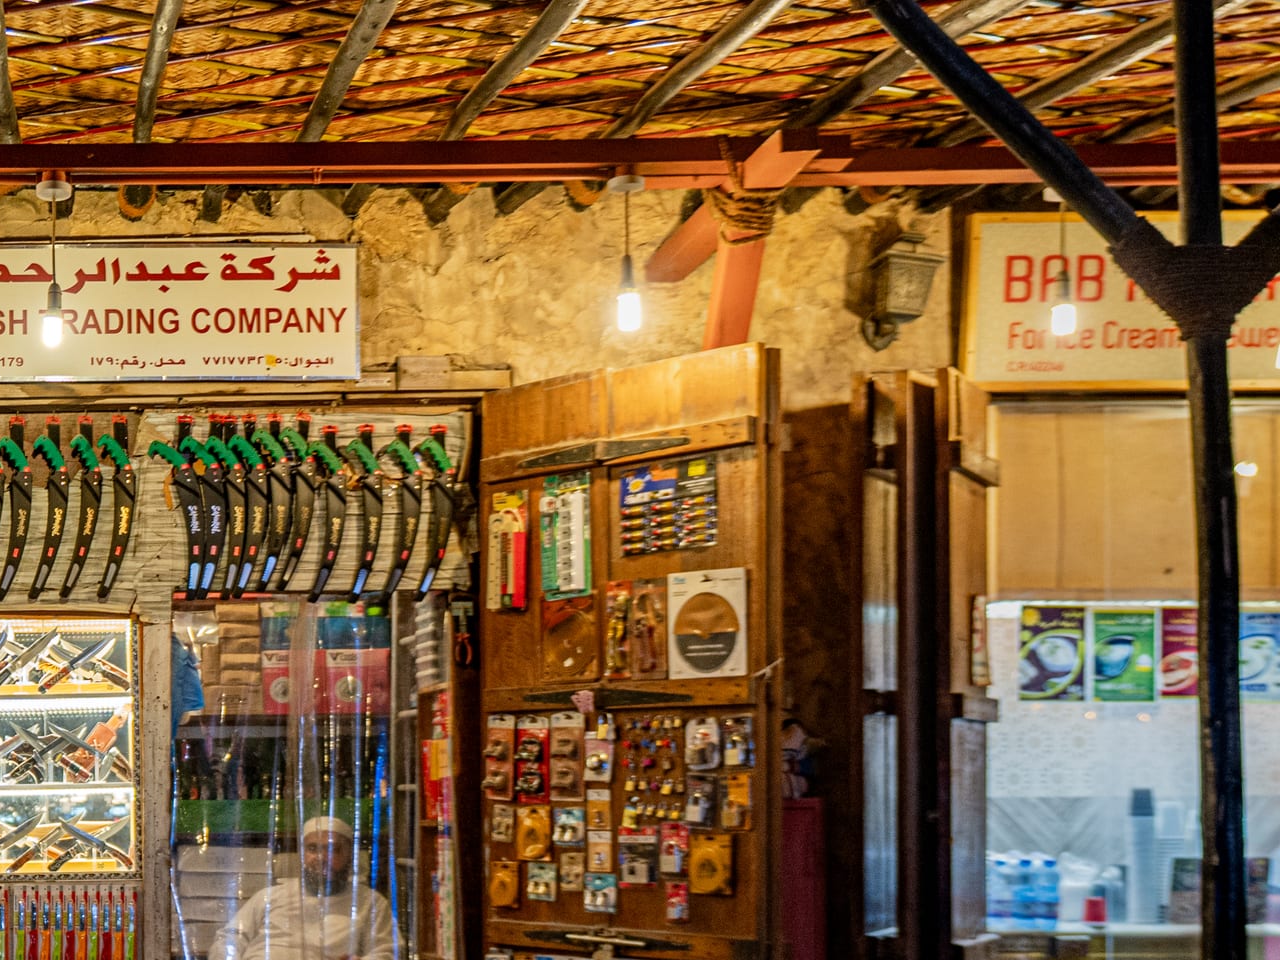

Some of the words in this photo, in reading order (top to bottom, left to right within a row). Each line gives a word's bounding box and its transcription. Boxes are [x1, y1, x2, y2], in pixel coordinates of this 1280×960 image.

[220, 249, 341, 292] شركة
[1004, 255, 1105, 302] BAB
[191, 307, 347, 334] COMPANY
[1008, 321, 1047, 349] For
[1102, 320, 1182, 349] Cream
